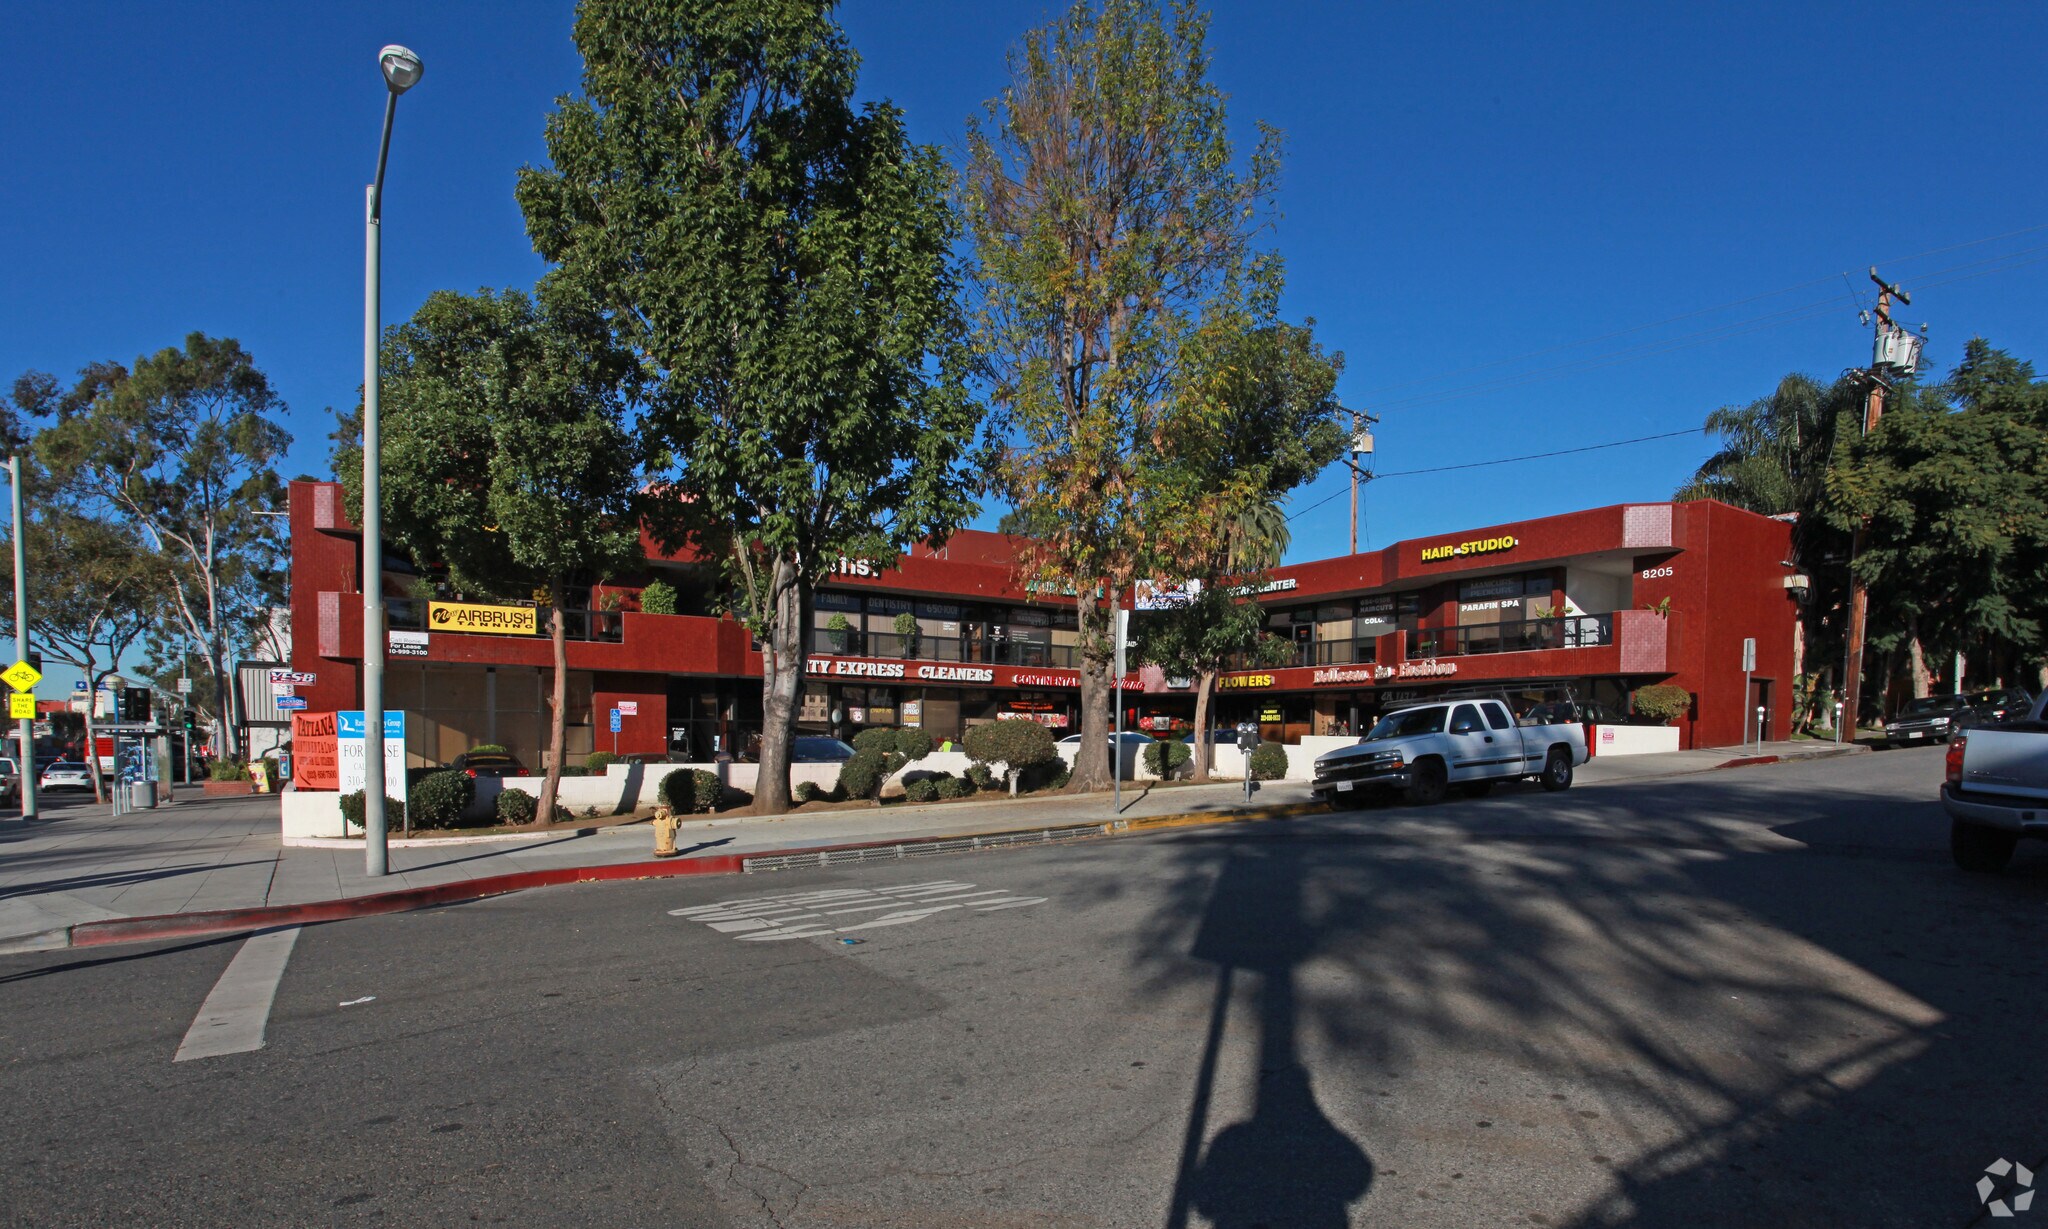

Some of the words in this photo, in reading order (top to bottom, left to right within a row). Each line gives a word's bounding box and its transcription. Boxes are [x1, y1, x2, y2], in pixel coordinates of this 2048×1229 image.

[1421, 545, 1454, 560] HAIR
[1460, 536, 1514, 554] STUDIO
[1642, 566, 1673, 579] 8205
[821, 593, 849, 605] FAMILY
[1471, 587, 1514, 598] PEDICURE
[868, 597, 912, 610] DENTISTRY
[1360, 603, 1393, 613] HAIRCUTS
[1461, 602, 1498, 612] PARAFIN
[1501, 600, 1519, 608] SPA
[457, 609, 534, 625] AIRBRUSH
[457, 620, 533, 629] TANNING
[836, 661, 904, 677] EXPRESS
[918, 666, 993, 682] CLEANERS
[1218, 674, 1271, 688] FLOWERS
[296, 714, 336, 736] TATIANA
[387, 718, 402, 728] Group
[343, 744, 363, 758] FOR
